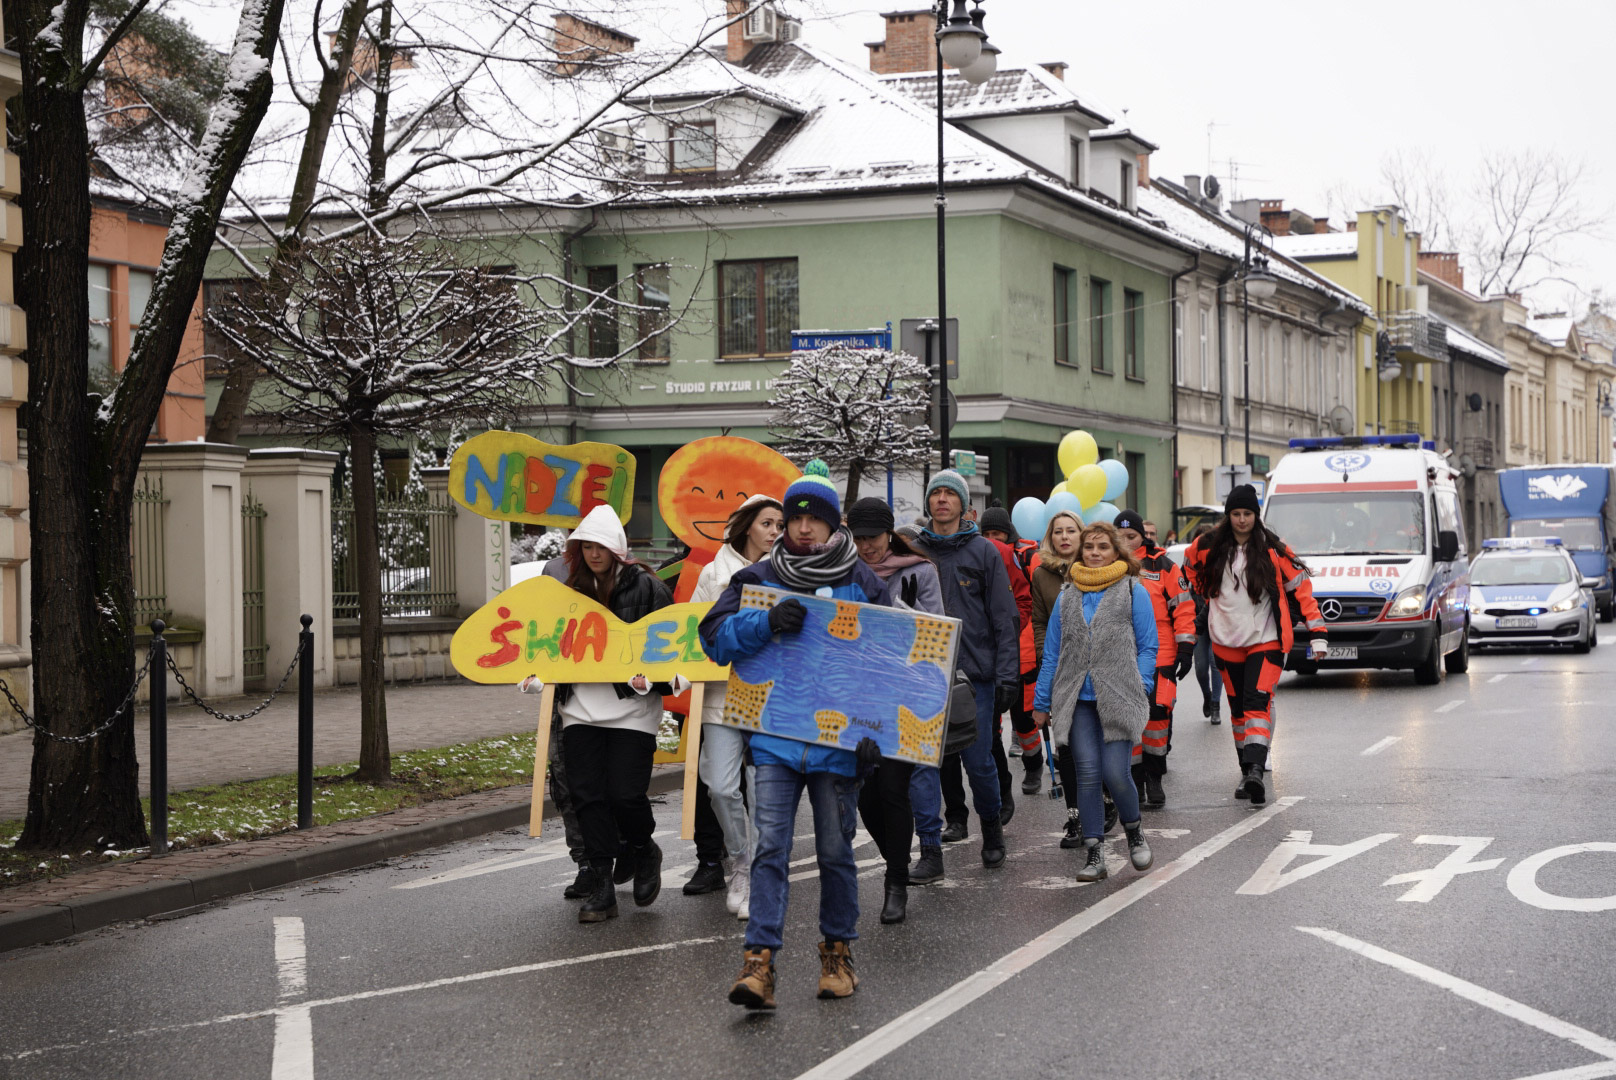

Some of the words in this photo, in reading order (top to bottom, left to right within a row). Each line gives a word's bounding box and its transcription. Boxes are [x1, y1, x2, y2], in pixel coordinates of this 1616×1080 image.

[799, 339, 812, 348] M.
[815, 337, 864, 349] Kopenika
[711, 379, 752, 392] FRYZUR
[476, 606, 716, 669] ŚWIATEŁ
[1330, 648, 1357, 657] 2577H
